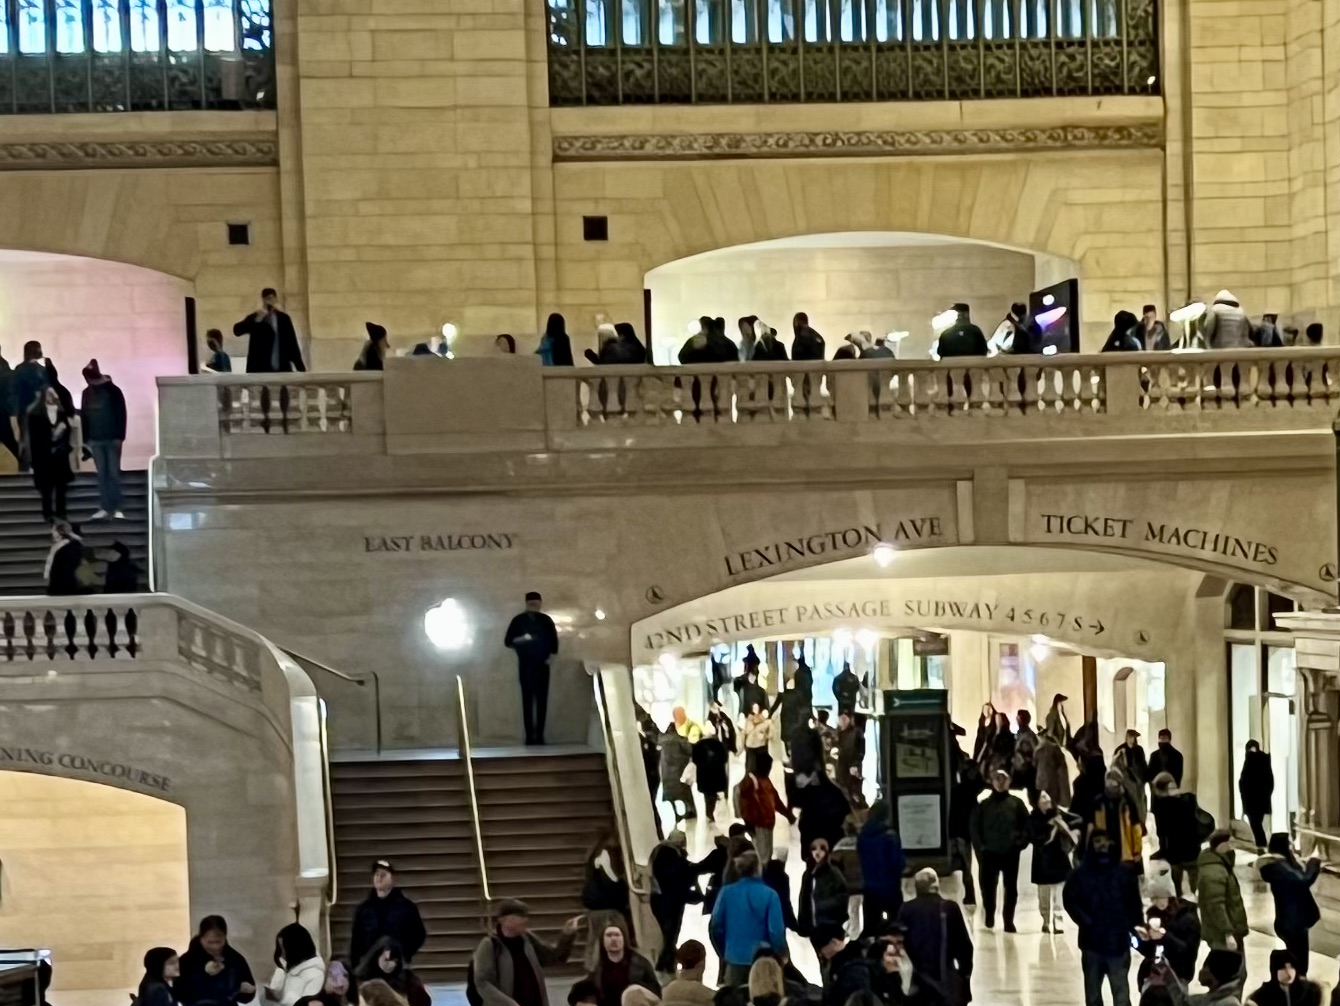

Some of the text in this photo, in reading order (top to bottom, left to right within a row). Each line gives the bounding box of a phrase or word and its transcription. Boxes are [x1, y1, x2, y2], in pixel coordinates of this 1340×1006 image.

[420, 532, 518, 551] BALCONY
[724, 516, 943, 576] LEXINGTON AVE
[1040, 513, 1279, 566] TICKET MACHINES
[645, 621, 701, 650] 42ND
[705, 607, 789, 634] STREET
[795, 599, 893, 622] PASSAGE
[903, 599, 1000, 621] SUBWAY
[57, 753, 173, 792] CONCOURSE
